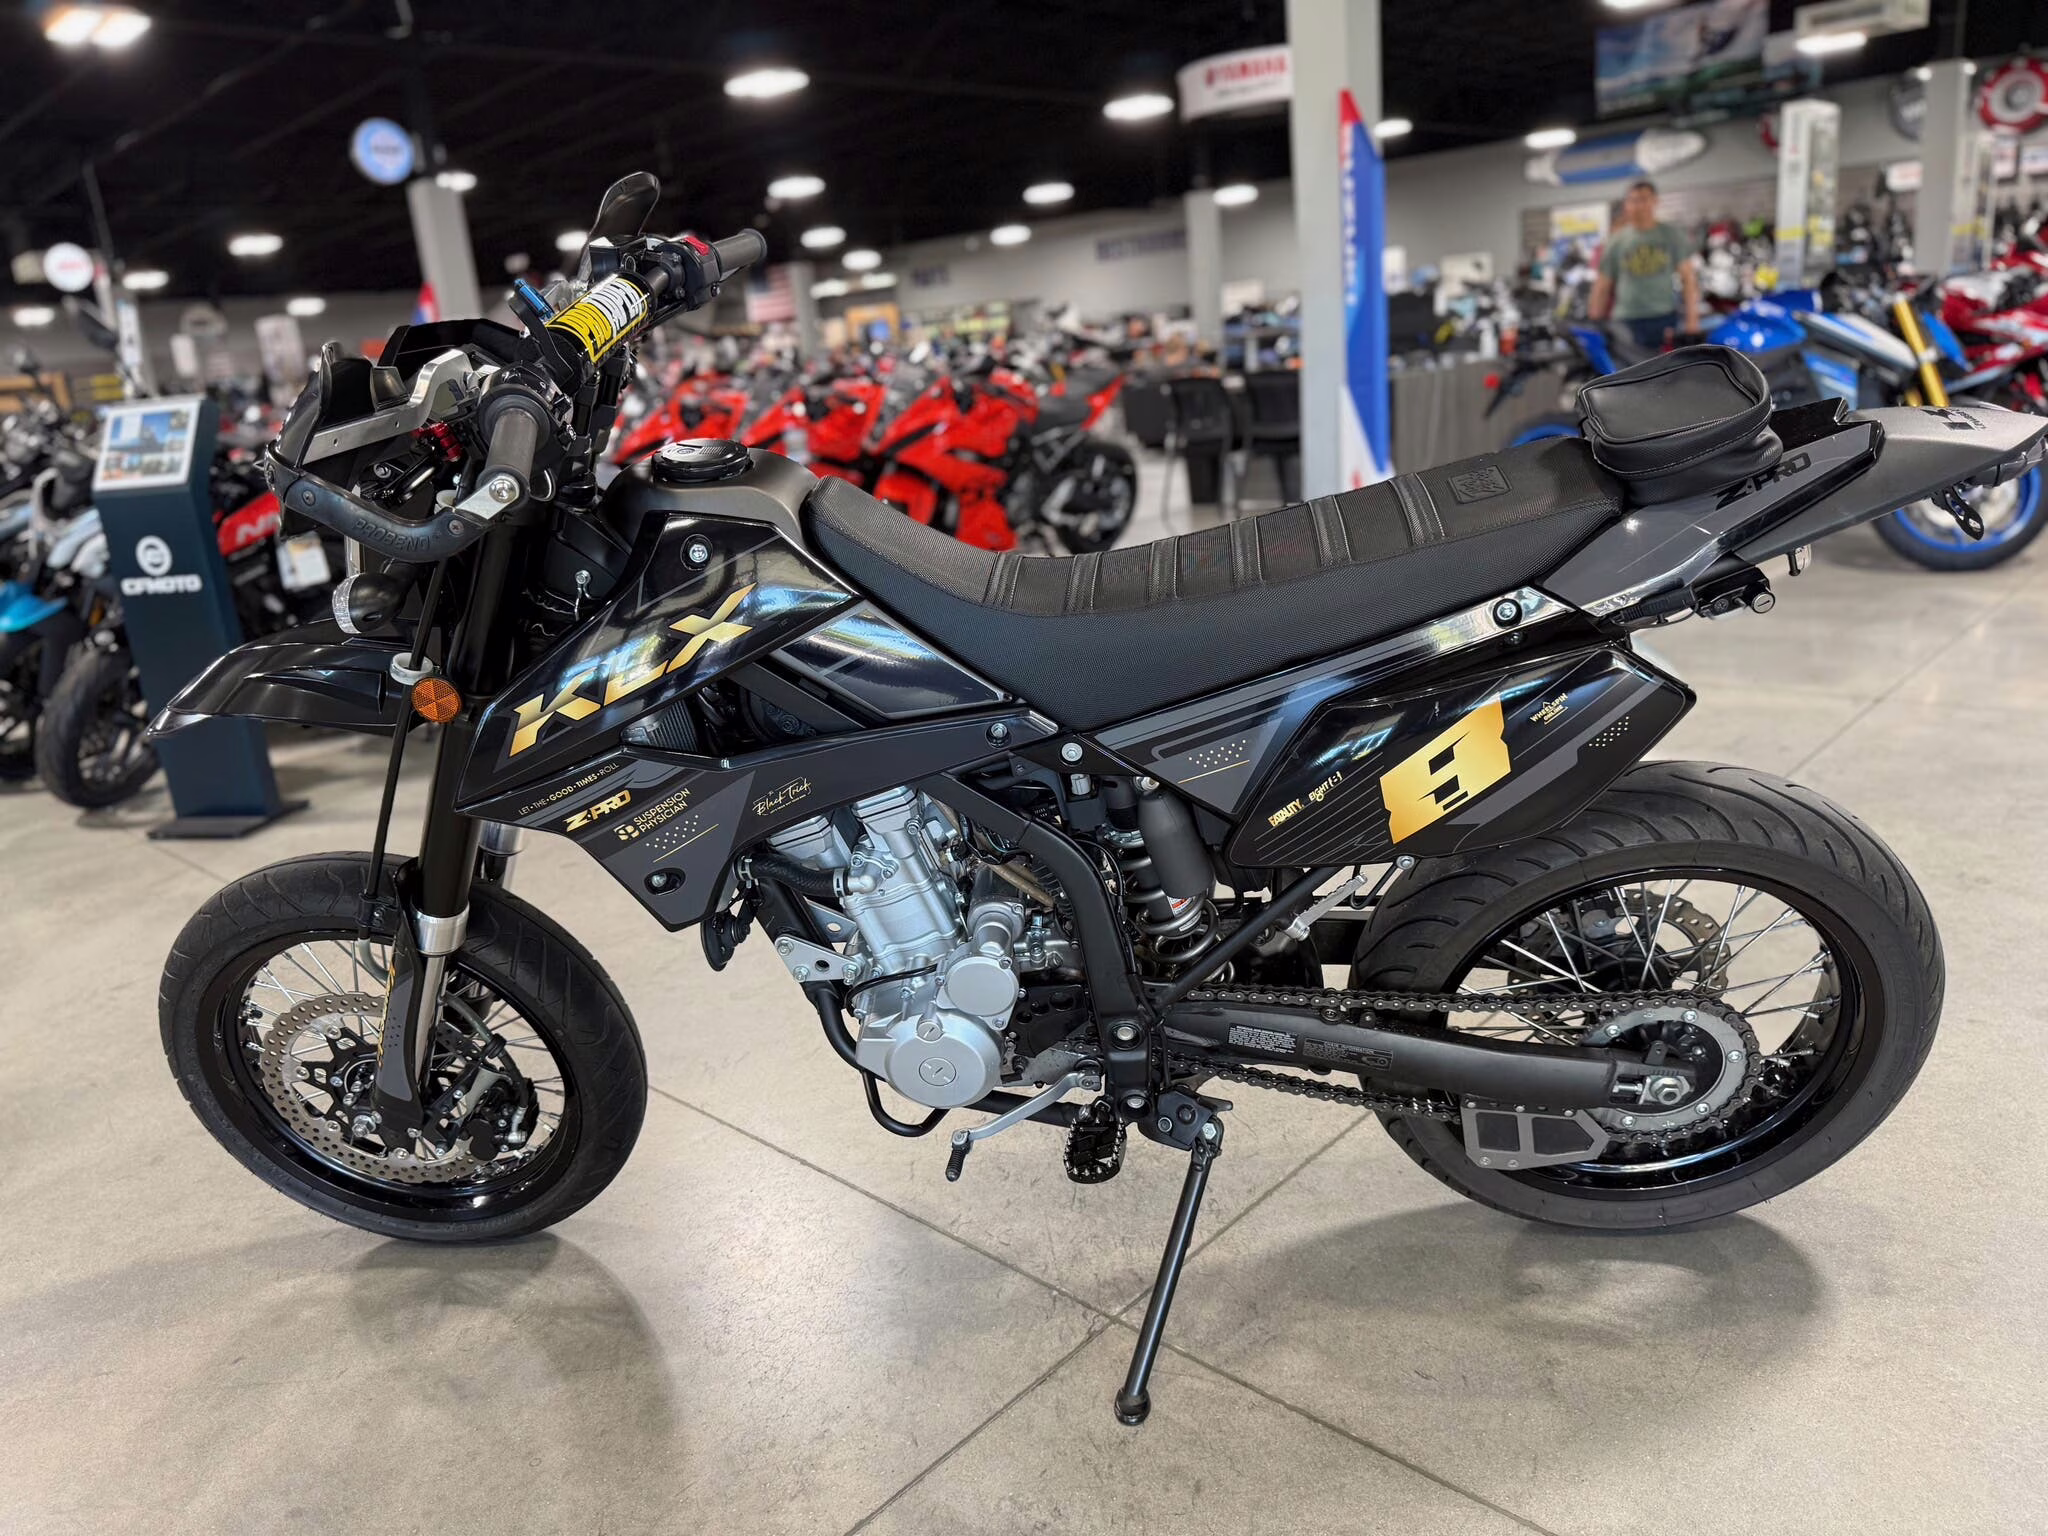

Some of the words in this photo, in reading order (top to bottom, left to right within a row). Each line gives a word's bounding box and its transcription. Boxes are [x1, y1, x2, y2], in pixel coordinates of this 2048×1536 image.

[510, 582, 757, 757] KLX
[1529, 692, 1569, 723] WHEELSPIN
[518, 806, 531, 816] LET
[533, 798, 547, 809] THE
[549, 785, 574, 801] GOOD
[576, 773, 598, 789] TIMES
[600, 762, 620, 777] ROLL
[633, 787, 691, 826] SUSPENSION
[752, 791, 786, 815] Black
[782, 778, 812, 800] Trick
[1308, 781, 1330, 801] EIGHT
[639, 800, 688, 833] PHYSICIAN
